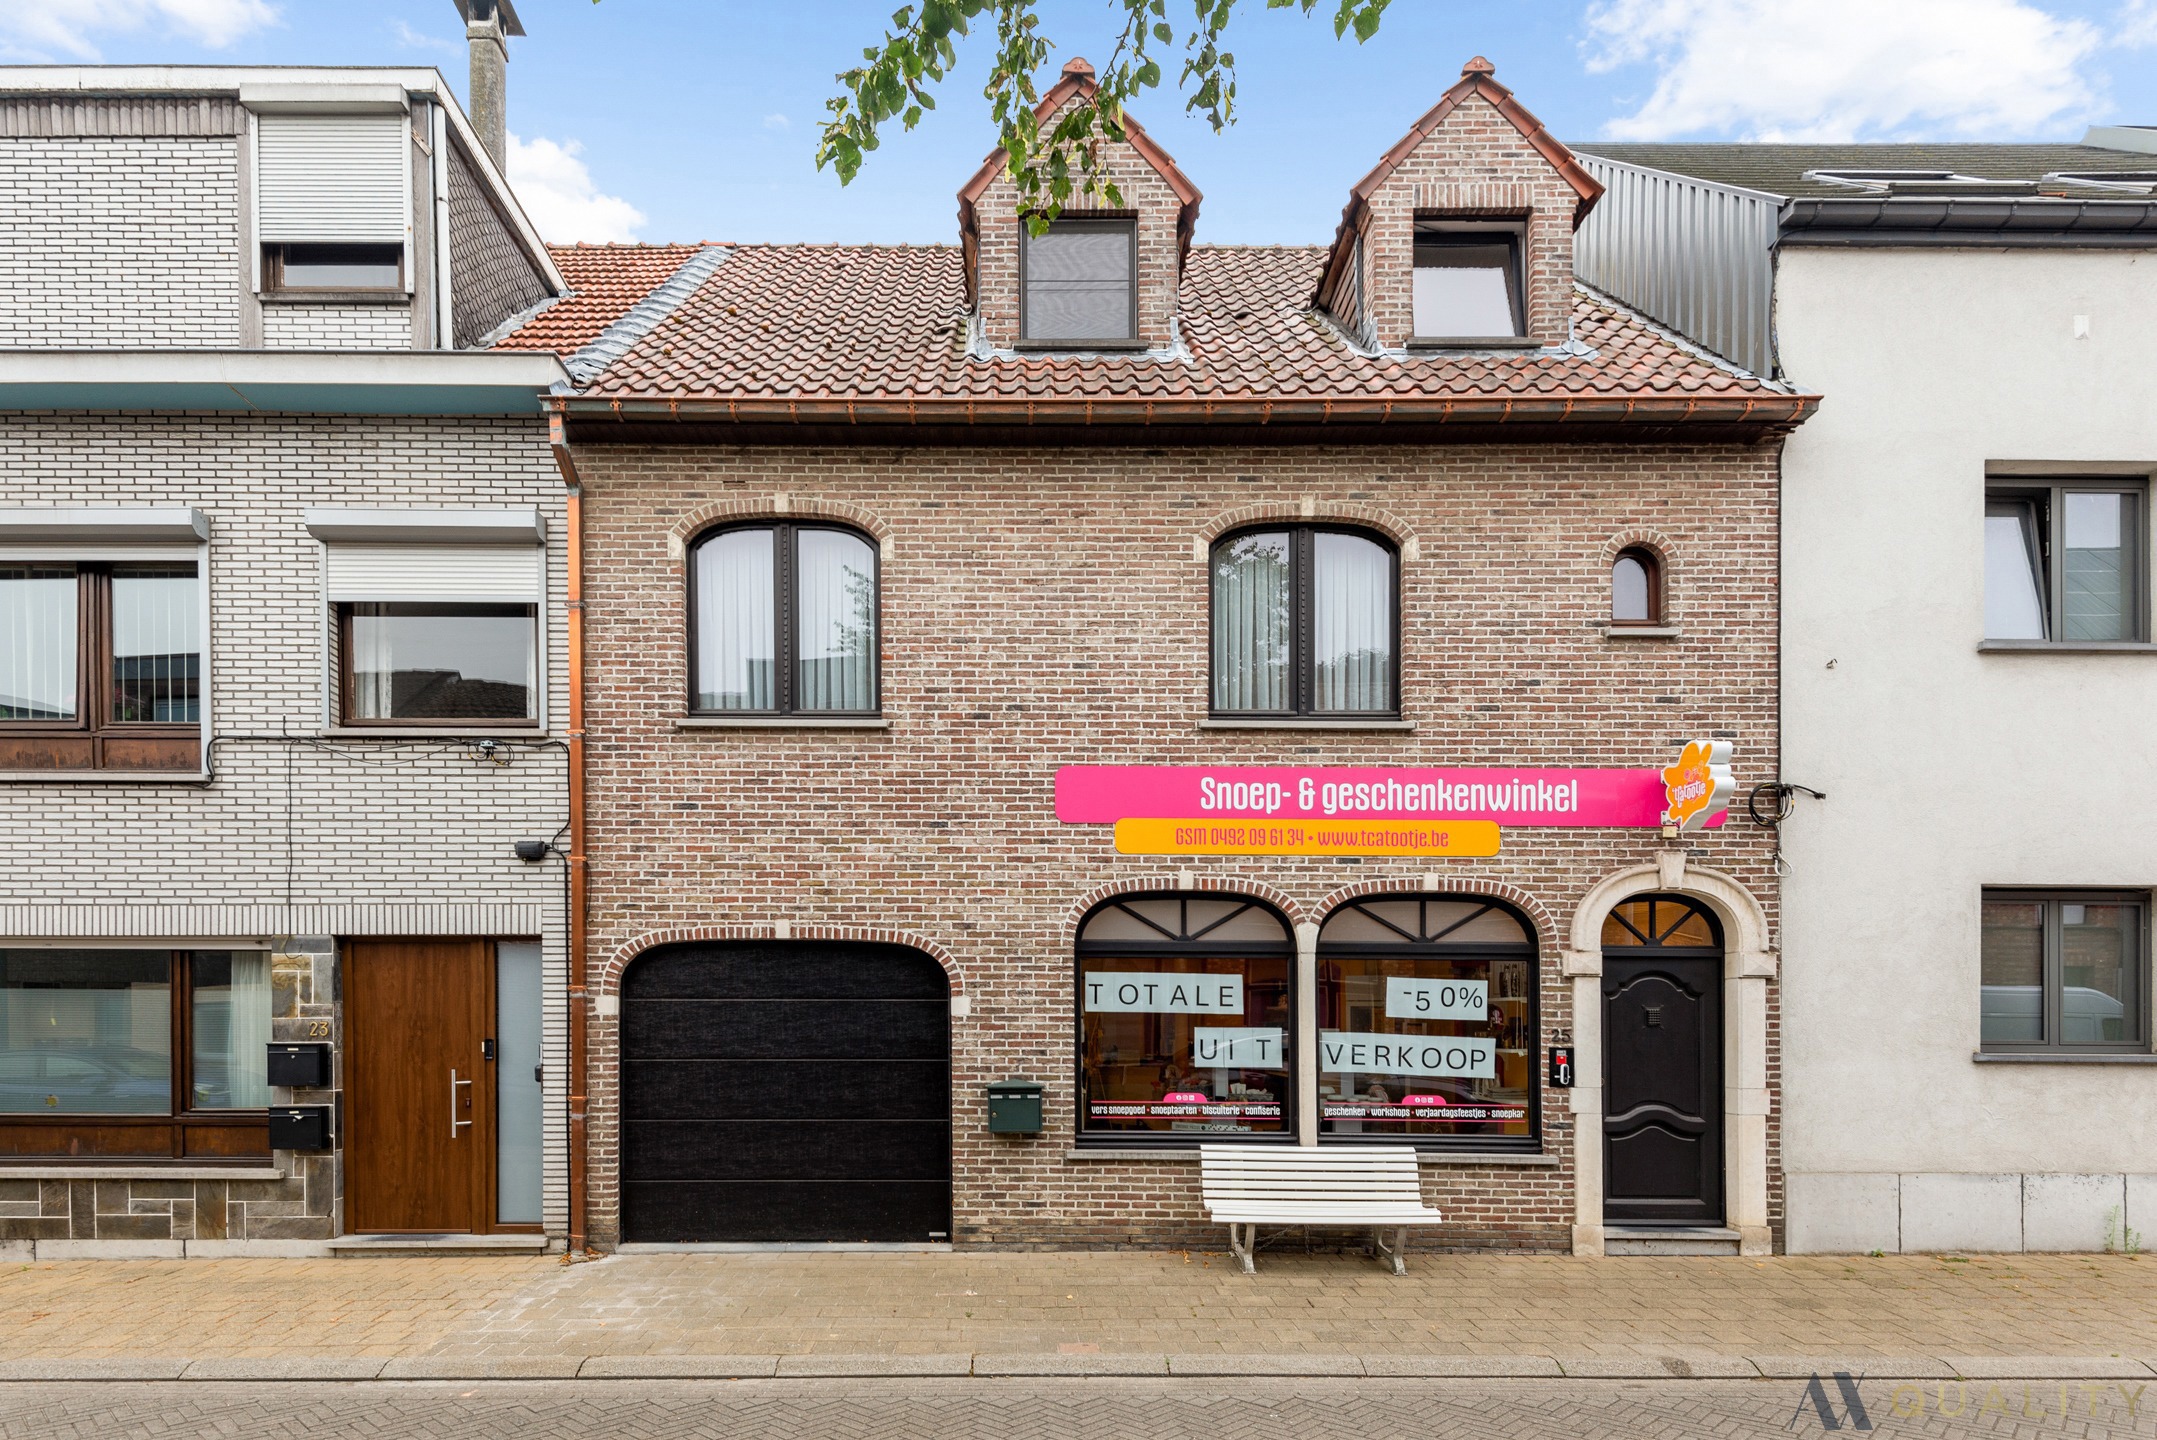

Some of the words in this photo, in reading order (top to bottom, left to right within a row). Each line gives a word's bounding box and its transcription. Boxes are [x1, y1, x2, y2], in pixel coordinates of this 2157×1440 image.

[1200, 776, 1292, 815] Snoep-
[1298, 777, 1317, 811] &
[1321, 777, 1578, 815] geschenkenwinkel
[1175, 827, 1207, 846] GSM
[1210, 827, 1246, 846] 0492
[1249, 827, 1267, 846] 09
[1269, 828, 1284, 846] 61
[1287, 828, 1305, 846] 34
[1317, 829, 1449, 850] www.tcatootje.be
[1088, 983, 1235, 1008] TOTALE
[309, 1021, 330, 1037] 23
[1551, 1029, 1571, 1043] 25
[1199, 1038, 1272, 1061] UIT
[1324, 1043, 1487, 1071] VERKOOP
[1091, 1106, 1108, 1115] vers
[1108, 1104, 1146, 1116] snoepgoed
[1150, 1104, 1198, 1116] snoeptaarten
[1202, 1105, 1240, 1116] biscuiterie
[1244, 1105, 1281, 1116] confiserie
[1323, 1106, 1366, 1117] geschenken
[1370, 1106, 1411, 1118] workshops
[1415, 1107, 1487, 1119] verjaardagsfeestjes
[1491, 1108, 1525, 1119] snoepkar
